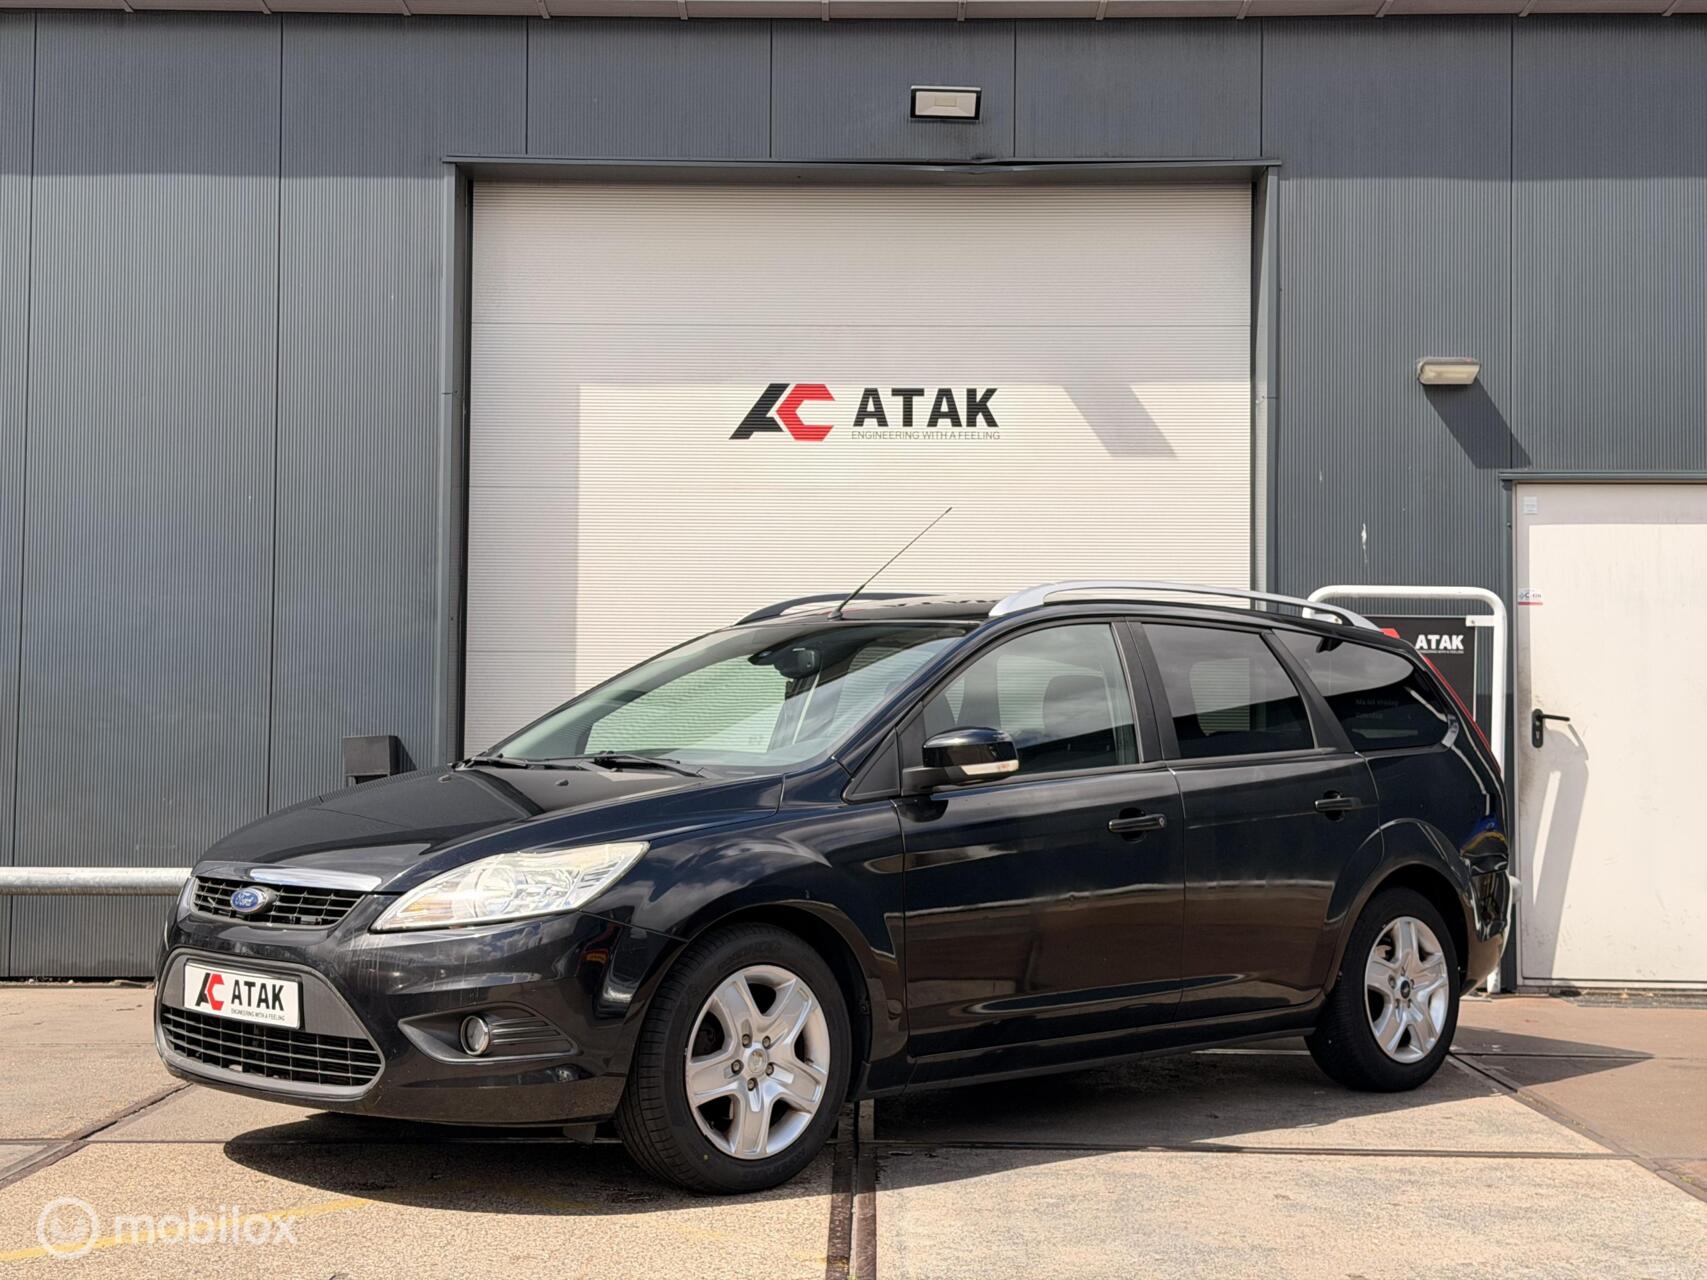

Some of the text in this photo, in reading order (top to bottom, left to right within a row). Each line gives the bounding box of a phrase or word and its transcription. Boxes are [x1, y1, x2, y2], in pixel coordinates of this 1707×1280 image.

[853, 388, 999, 427] ATAK
[851, 431, 1001, 441] ENGINEERING WITH A FEELING
[1415, 634, 1464, 650] ATAK
[231, 979, 285, 1011] ATAK
